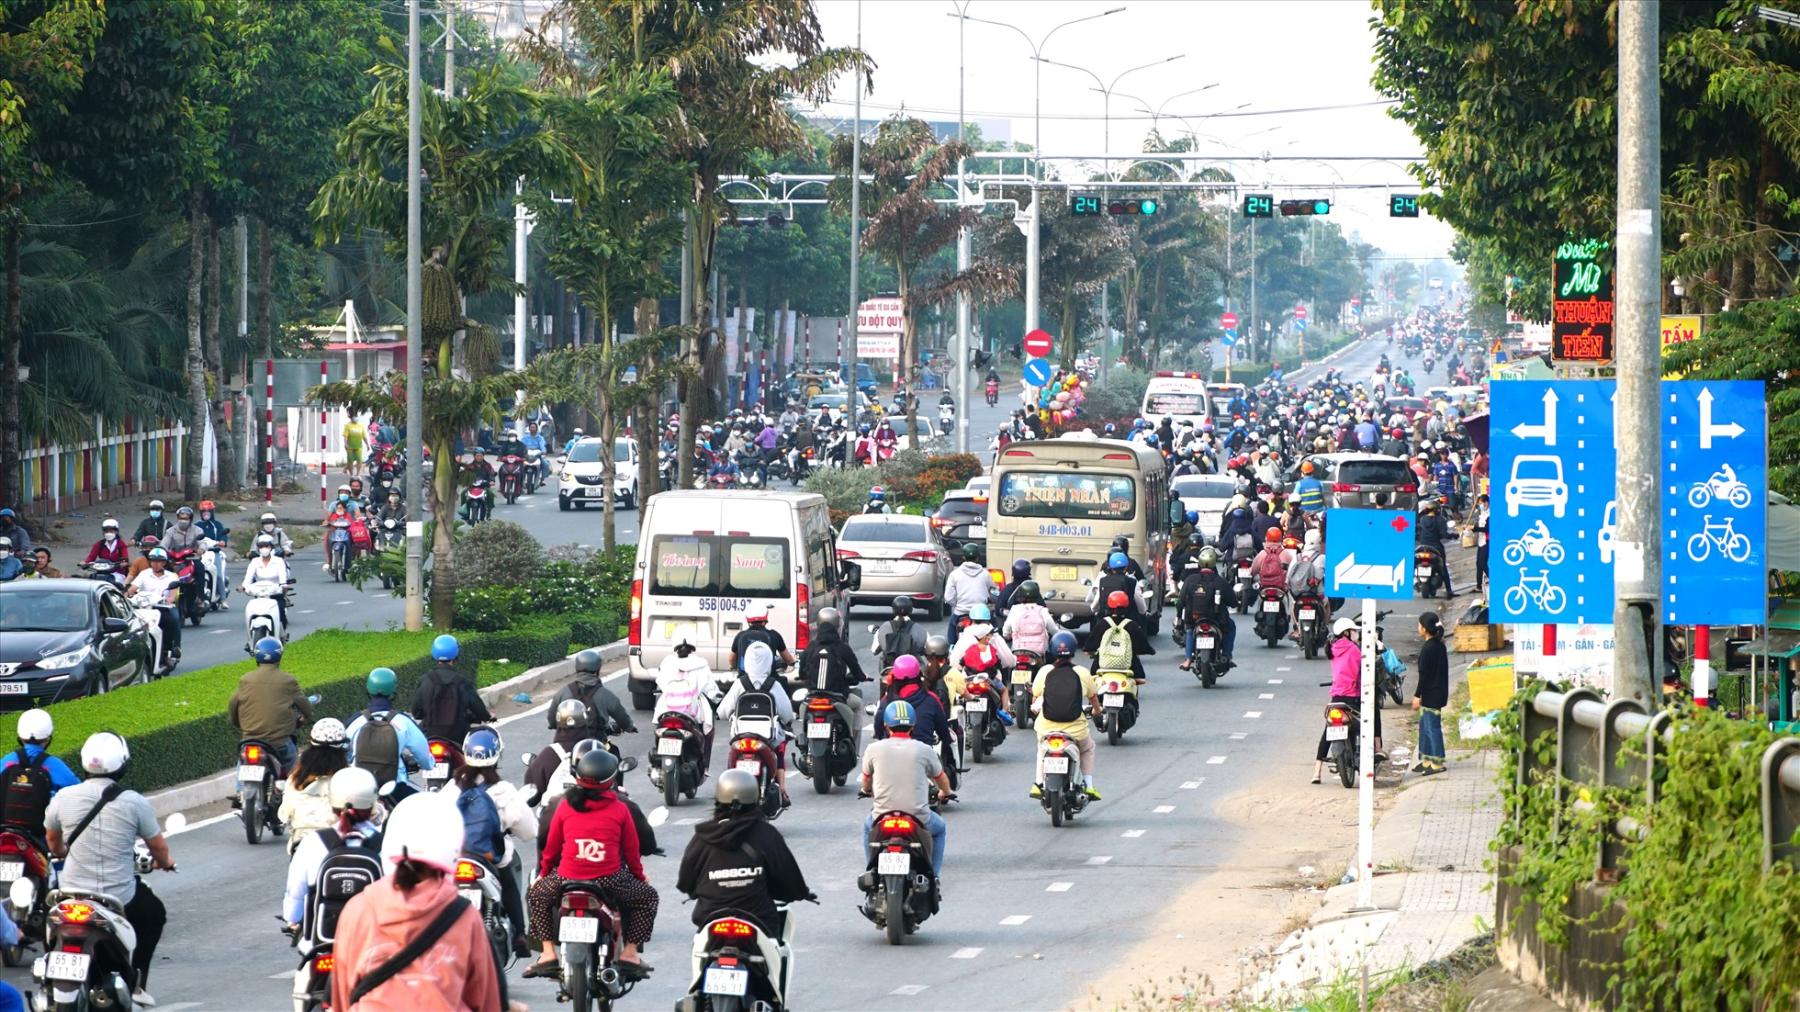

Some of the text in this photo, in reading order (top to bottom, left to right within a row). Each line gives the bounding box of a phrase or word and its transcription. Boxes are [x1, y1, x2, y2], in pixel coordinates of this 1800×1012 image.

[1076, 197, 1097, 212] 24
[1248, 197, 1269, 213] 24
[1394, 197, 1415, 212] 24
[1555, 295, 1613, 326] THUẬN
[1662, 323, 1694, 344] TẤM
[1562, 327, 1604, 358] TIẾN
[1039, 524, 1092, 537] 94B-003.01
[0, 684, 23, 693] 78.51
[575, 838, 606, 862] DG
